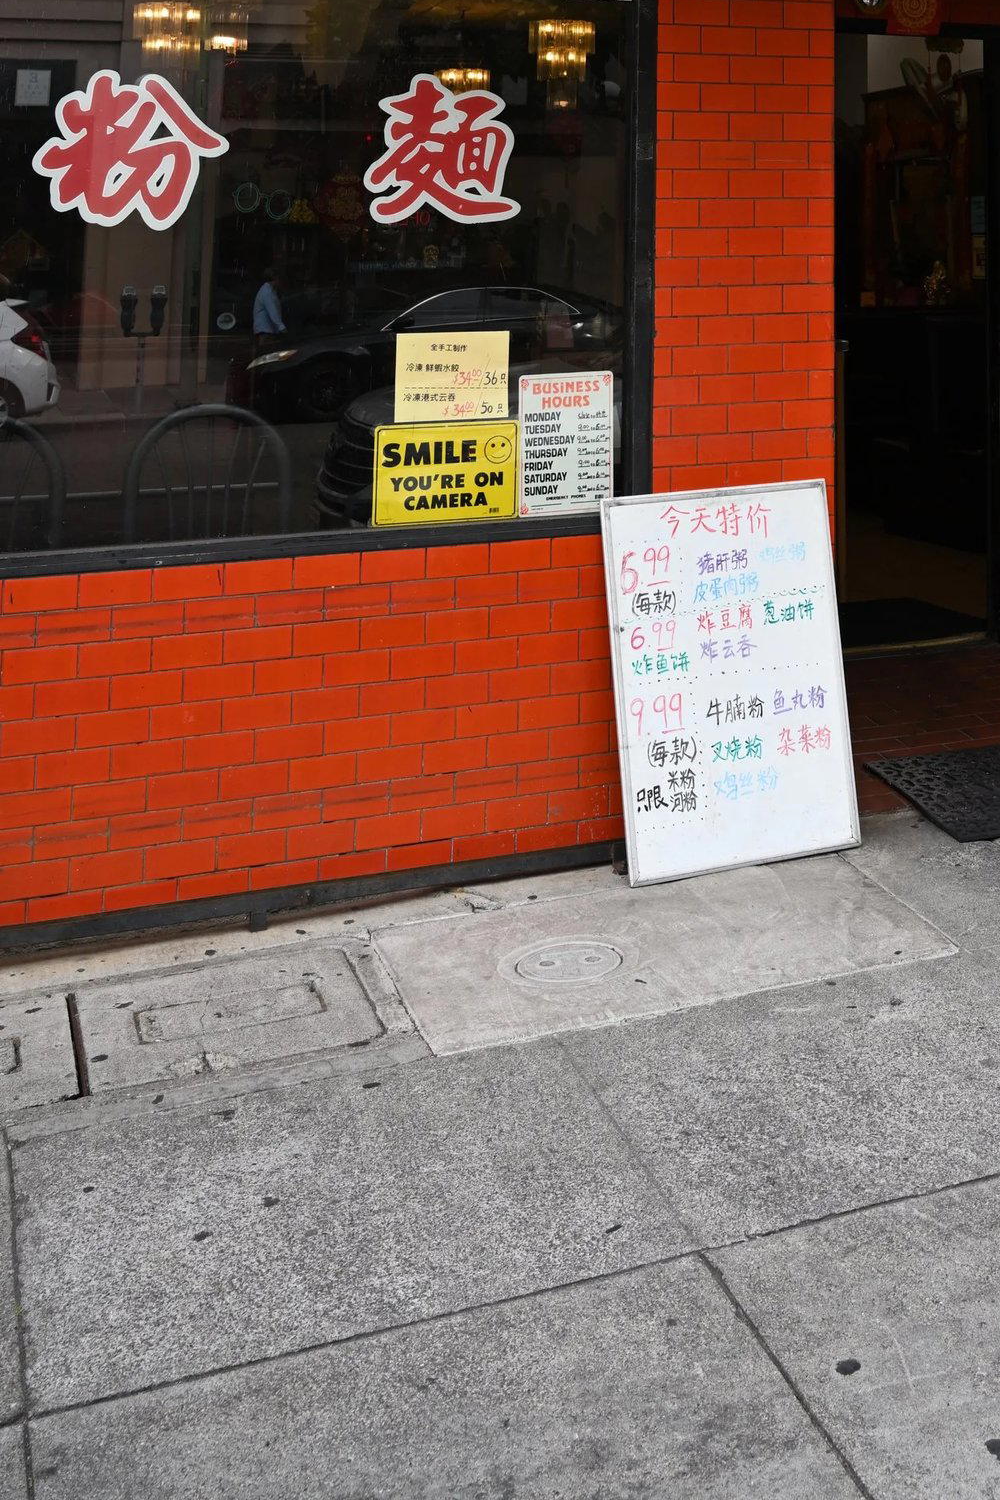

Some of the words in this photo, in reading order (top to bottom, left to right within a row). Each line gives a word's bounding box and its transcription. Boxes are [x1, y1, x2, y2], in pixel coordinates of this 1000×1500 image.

[40, 73, 224, 224] 粉
[430, 343, 468, 353] 全手工制作
[541, 395, 591, 410] HOURS
[524, 411, 561, 423] MONDAY
[525, 423, 561, 435] TUESDAY
[524, 435, 575, 448] WEDNESDAY
[382, 440, 477, 468] SMILE
[525, 447, 568, 460] THURSDAY
[524, 460, 554, 472] FRIDAY
[390, 474, 465, 492] YOU'RE
[474, 471, 504, 488] ON
[524, 472, 567, 484] SATURDAY
[524, 484, 558, 497] SUNDAY
[404, 492, 488, 511] CAMERA
[660, 503, 771, 539] 今天特价
[696, 549, 749, 575] 猪肝粥
[696, 600, 754, 634] 炸豆腐
[700, 634, 757, 663] 炸云吞
[631, 652, 690, 676] 炸鱼饼
[706, 693, 765, 726] 牛腩粉
[711, 734, 765, 763] 叉烧粉
